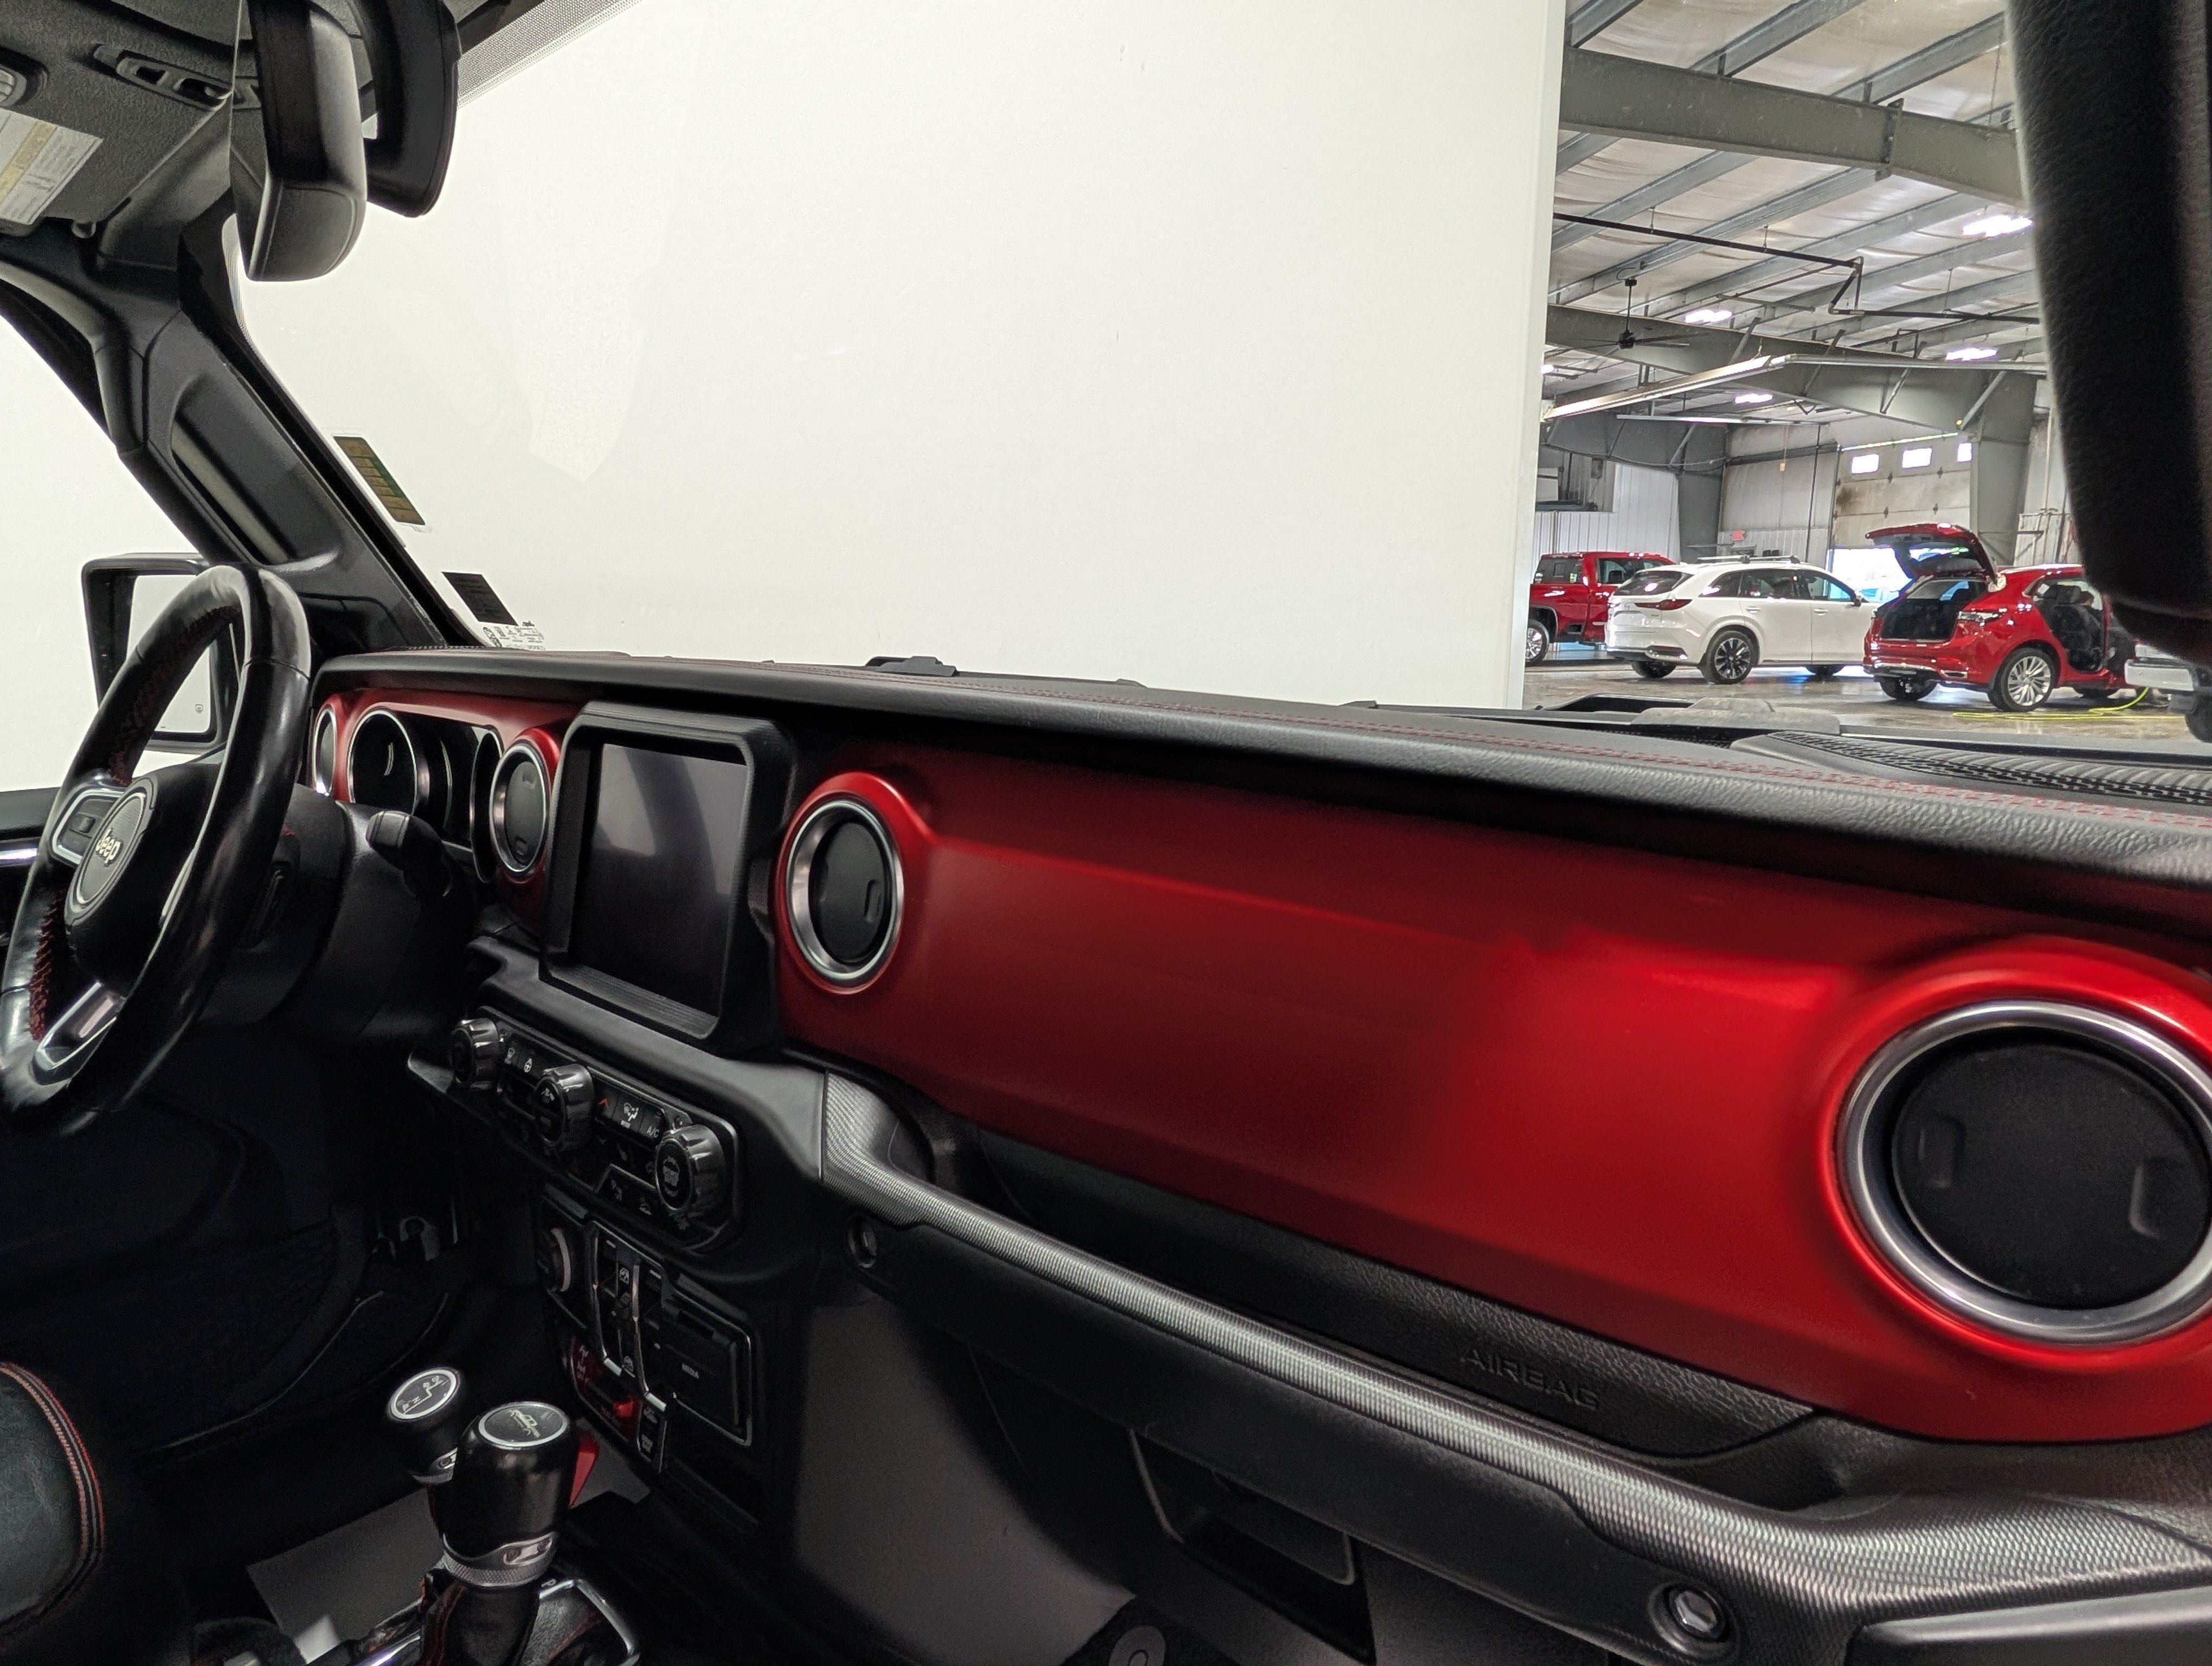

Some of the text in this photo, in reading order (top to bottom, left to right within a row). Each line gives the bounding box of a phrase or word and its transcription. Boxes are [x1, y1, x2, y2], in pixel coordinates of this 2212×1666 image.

[95, 829, 123, 866] Jeep
[646, 1125, 660, 1138] A/C
[1459, 1348, 1600, 1412] AIRBAG
